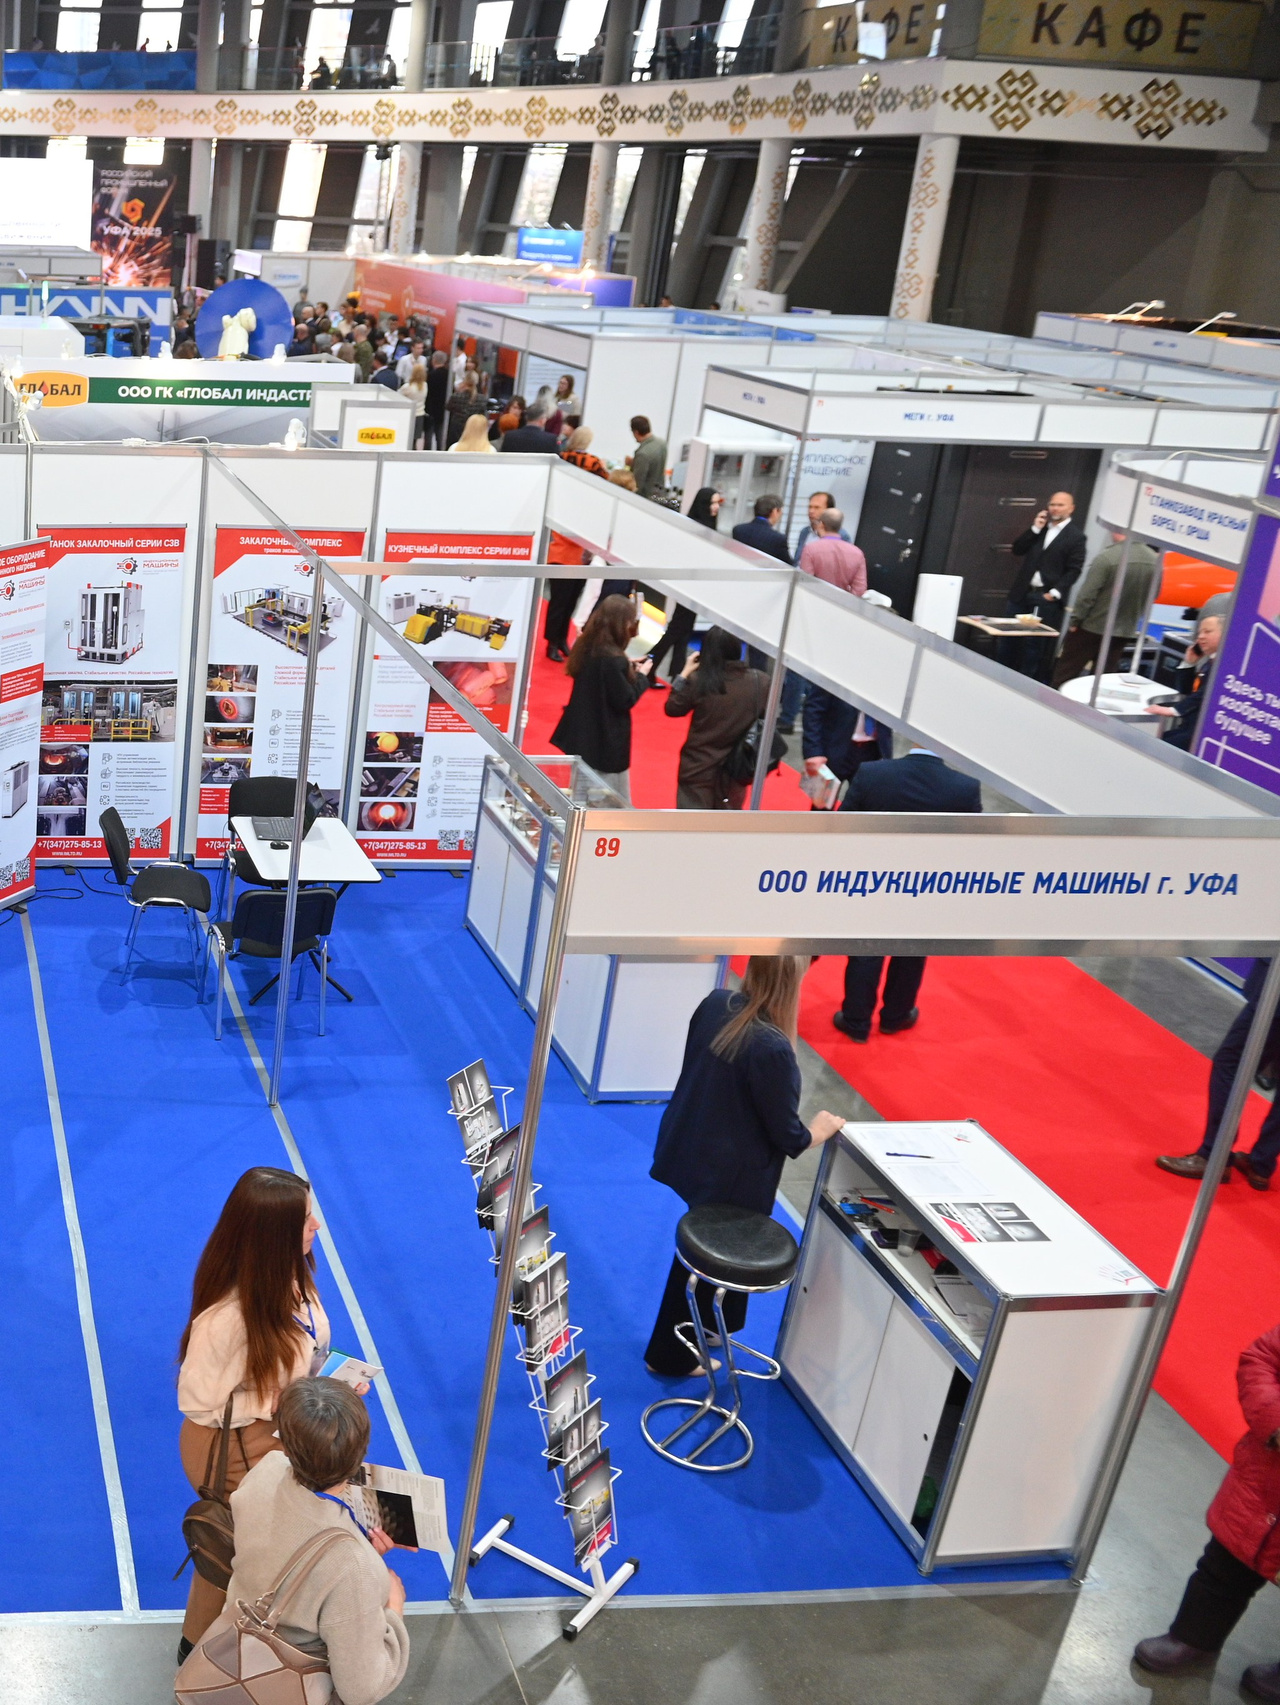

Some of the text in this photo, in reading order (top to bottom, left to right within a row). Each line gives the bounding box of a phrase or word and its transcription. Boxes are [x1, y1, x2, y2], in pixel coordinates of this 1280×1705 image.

[833, 5, 920, 53] КФЕ
[1031, 2, 1207, 53] КАФЕ
[103, 225, 162, 237] УФА 2025
[117, 386, 312, 402] ООО ГК «ГЛОБАЛ ИНДАСТР
[936, 413, 954, 422] УФА
[790, 453, 867, 465] ОМПЛЕКСНОЕ
[789, 465, 852, 477] СНАЩЕНИЕ
[1206, 510, 1249, 532] КРАСНЫЙ
[1151, 514, 1177, 532] БОРЕЦ
[1186, 525, 1210, 541] ОРША
[49, 538, 180, 548] ТАНОК ЗАКАЛОЧНЫЙ СЕРИИ СЗВ
[239, 537, 343, 547] ЗАКАЛОЧНЫ ОМПЛЕКС
[388, 543, 529, 556] КУЗНЕЧНЫЙ КОМПЛЕКС СЕРИИ КИН
[16, 561, 37, 572] нагрева
[18, 580, 45, 590] МАШИНЫ
[1223, 674, 1264, 701] Здесь
[1214, 710, 1272, 745] будущее
[37, 840, 102, 850] +7(347)275-85-13
[363, 841, 427, 851] +7(347)275-85-13
[593, 836, 621, 858] 89
[758, 869, 1239, 898] ООО ИНДУКЦИОННЫЕ МАШИНЫ г. УФА
